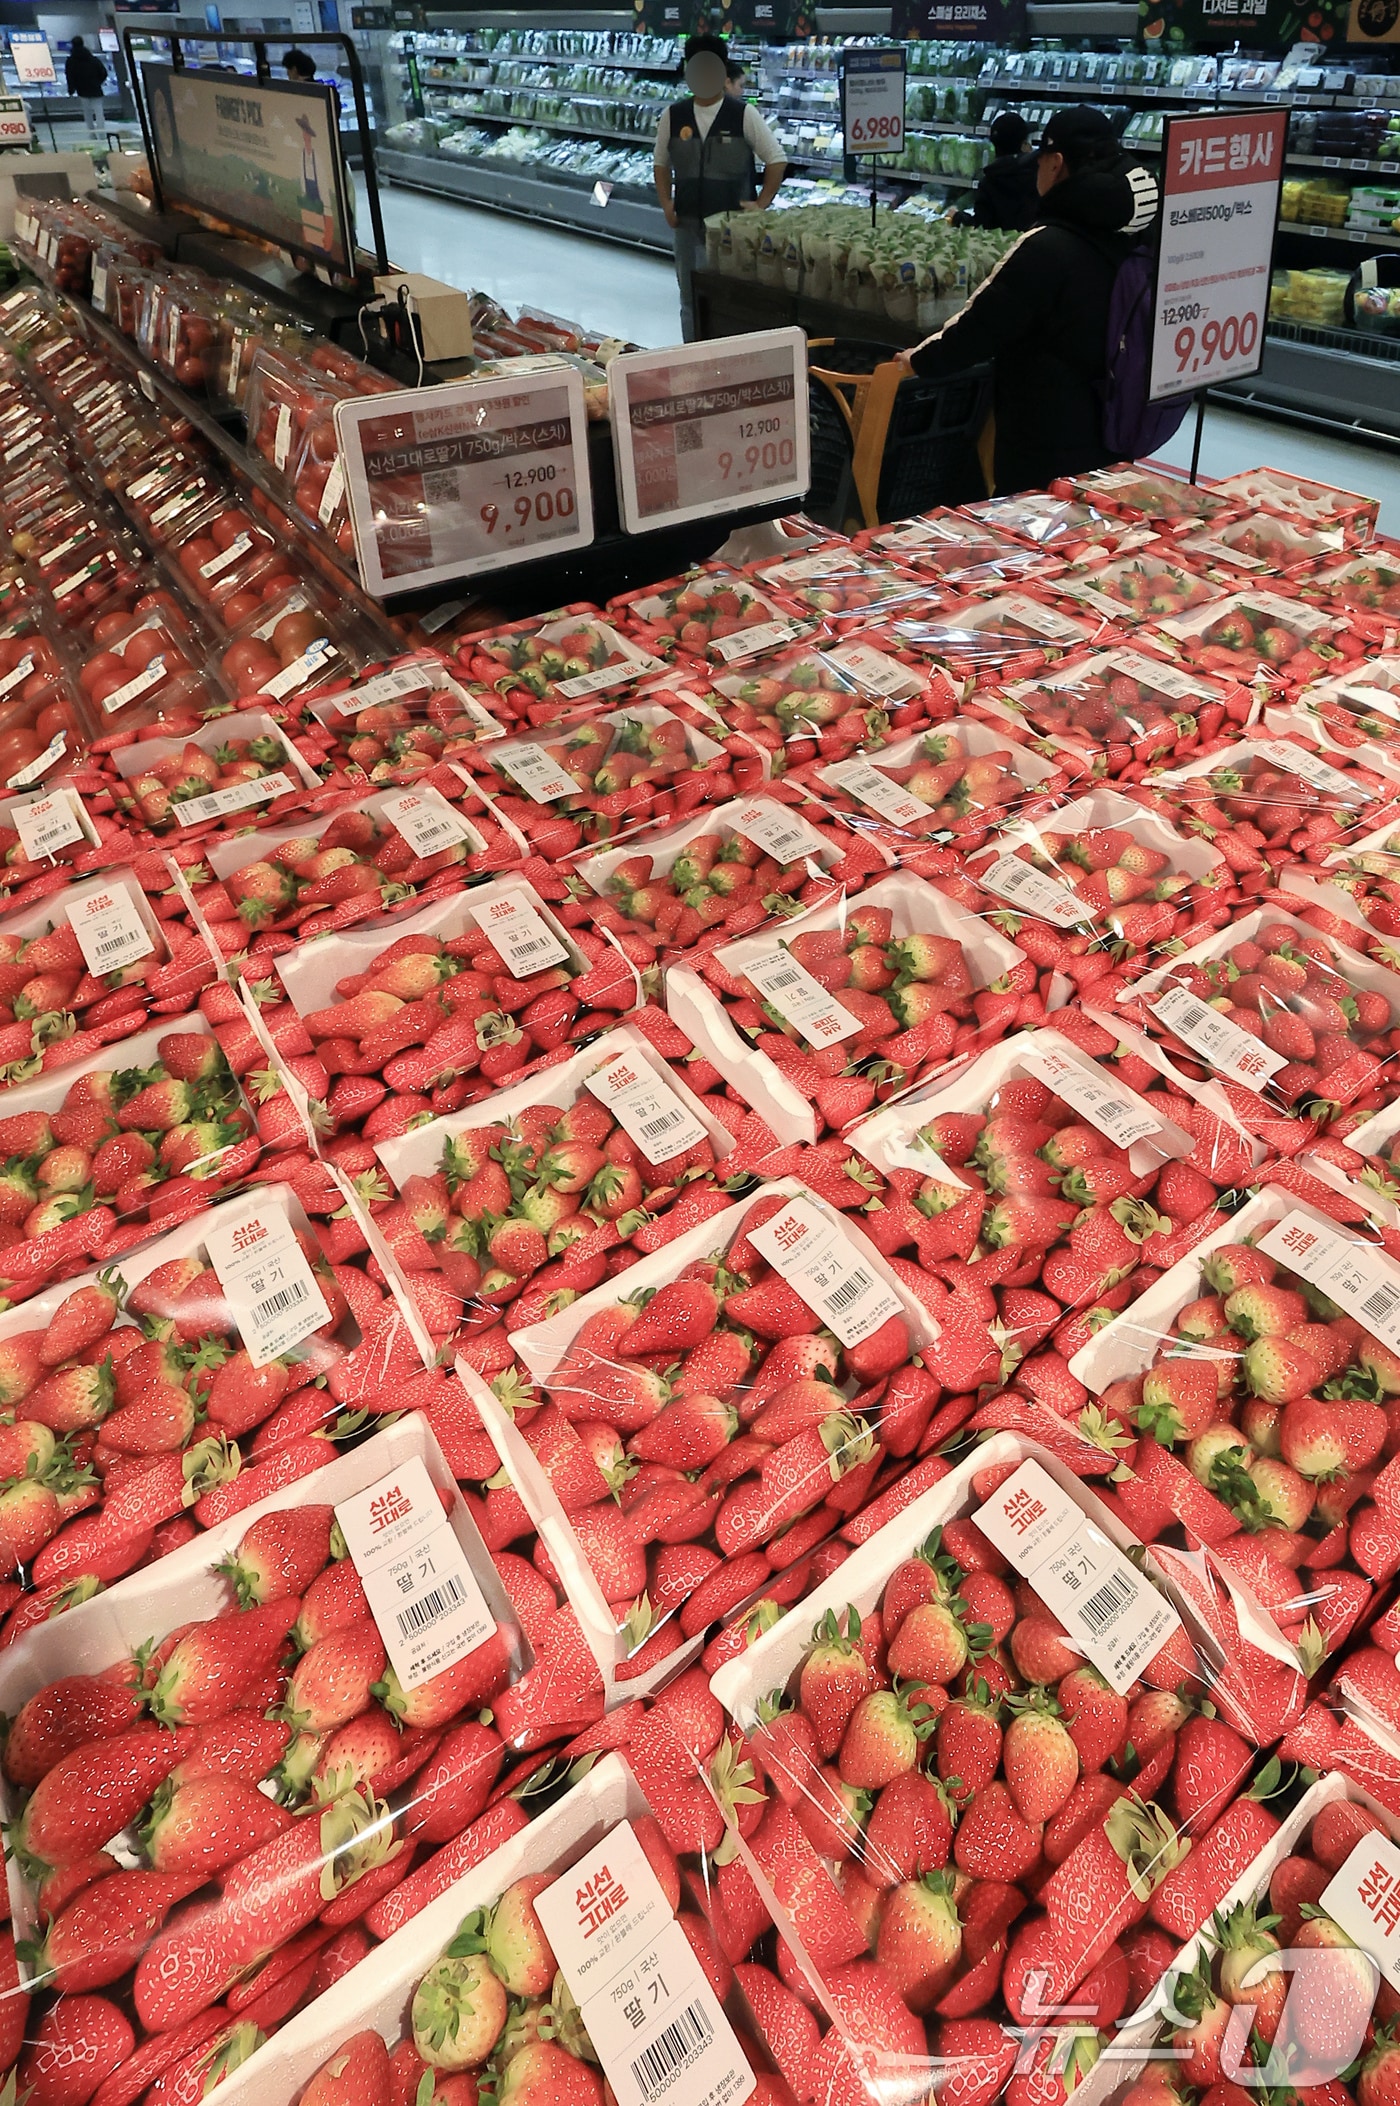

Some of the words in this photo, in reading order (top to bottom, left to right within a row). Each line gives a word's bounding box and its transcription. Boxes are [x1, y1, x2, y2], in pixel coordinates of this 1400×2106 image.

[928, 6, 953, 20] 스페셜
[851, 116, 901, 141] 6,980
[1178, 131, 1274, 176] 카드행사
[1162, 302, 1201, 326] 12,900
[1174, 311, 1258, 373] 9,900
[367, 442, 464, 476] 신선그대로딸기
[466, 424, 567, 456] 750g/박스(스치)
[608, 1065, 630, 1084] 신선
[610, 1072, 638, 1092] 그대로
[232, 1218, 262, 1242] 신선
[232, 1228, 269, 1254] 그대로
[773, 1216, 799, 1242] 신선
[777, 1222, 810, 1252] 그대로
[1280, 1226, 1306, 1247] 신선
[1290, 1232, 1319, 1257] 그대로
[250, 1278, 266, 1294] 딸
[270, 1266, 284, 1283] 기
[814, 1272, 830, 1288] 딸
[828, 1259, 844, 1276] 기
[1342, 1280, 1359, 1294] 딸
[1352, 1270, 1369, 1284] 기
[369, 1498, 414, 1534] 그대로
[370, 1486, 404, 1517] 신선
[1003, 1488, 1033, 1520] 신선
[1010, 1500, 1048, 1536] 그대로
[387, 1560, 409, 1577] 750g
[414, 1544, 430, 1558] 국산
[1049, 1559, 1067, 1574] 750g
[1067, 1542, 1082, 1556] 국산
[1062, 1570, 1082, 1590] 딸
[1078, 1555, 1096, 1576] 기
[396, 1572, 415, 1594] 딸
[418, 1558, 436, 1580] 기
[408, 1618, 437, 1641] 500000
[438, 1598, 466, 1620] 203343
[1091, 1636, 1098, 1644] 2
[1098, 1613, 1120, 1637] 500000
[1119, 1590, 1140, 1614] 203343
[576, 1865, 615, 1914] 신선
[1357, 1860, 1394, 1912] 신선
[578, 1884, 629, 1940] 그대로
[609, 1914, 628, 1934] 없으면
[576, 1954, 599, 1976] 100%
[632, 1900, 656, 1927] 드립니다
[610, 1978, 634, 2004] 750g
[640, 1952, 660, 1974] 국산
[622, 1996, 646, 2030] 딸
[648, 1972, 670, 2004] 기
[650, 2068, 682, 2103] 500000
[682, 2034, 714, 2070] 203343
